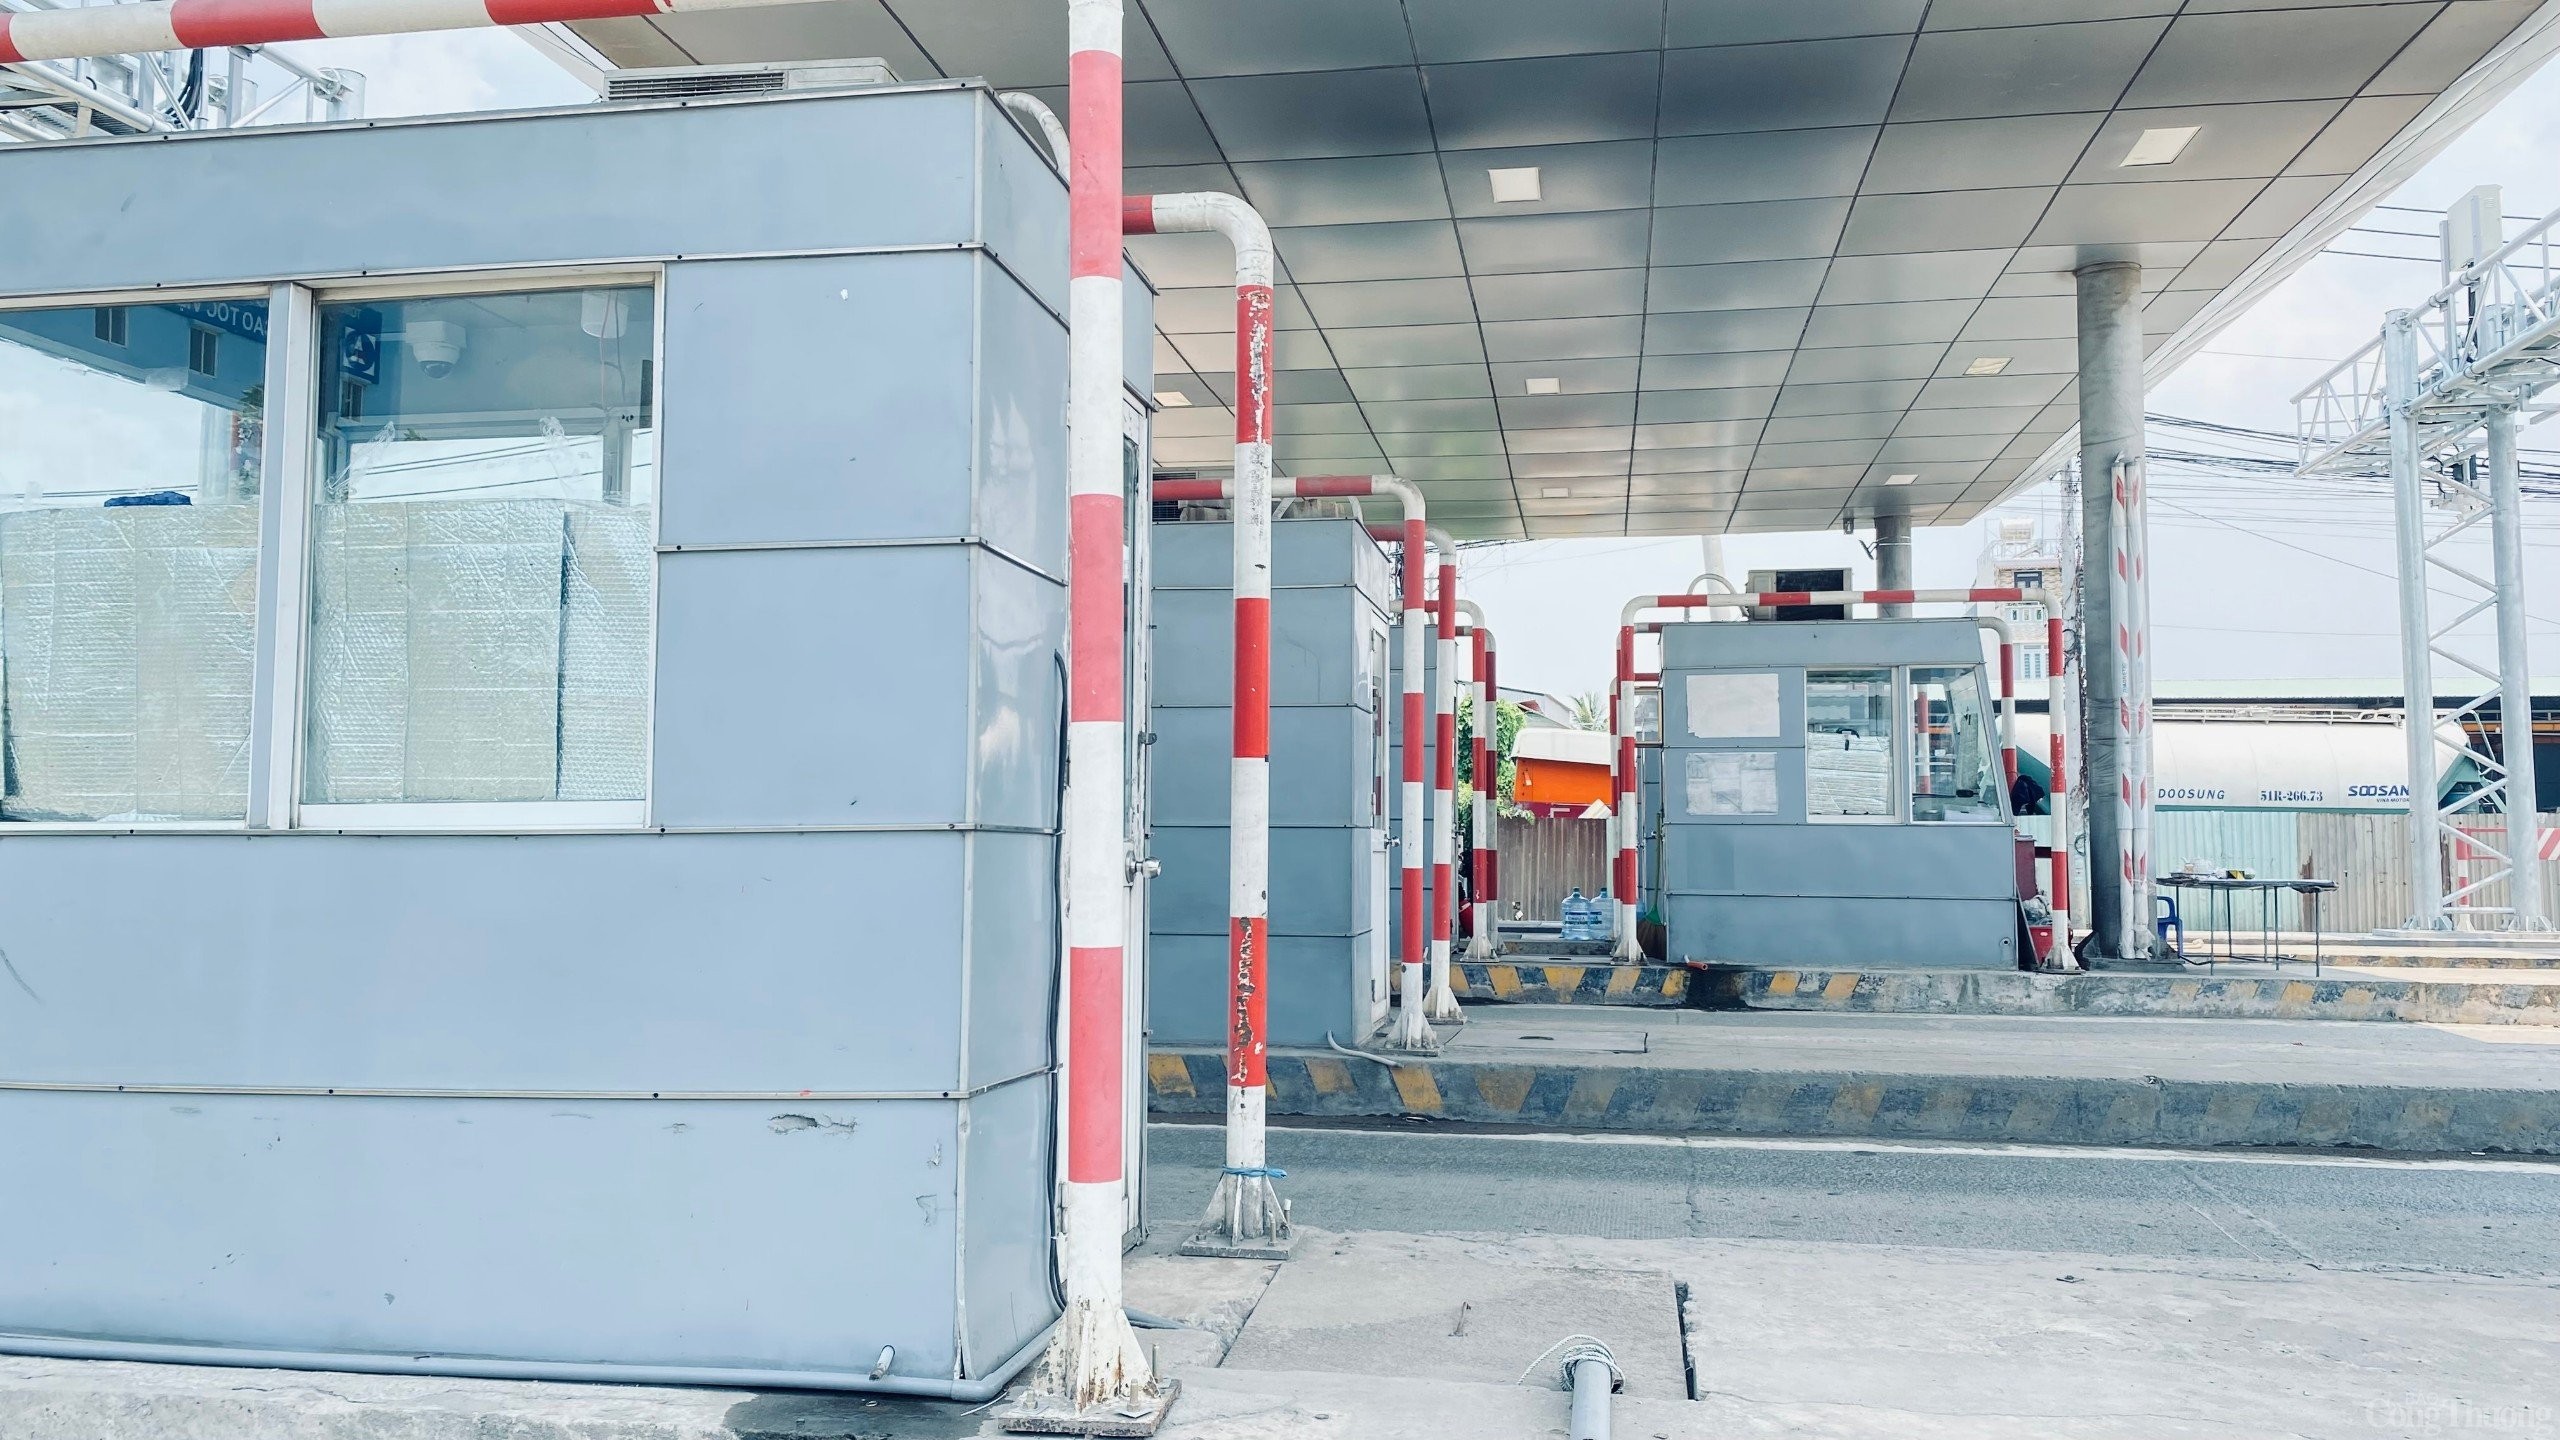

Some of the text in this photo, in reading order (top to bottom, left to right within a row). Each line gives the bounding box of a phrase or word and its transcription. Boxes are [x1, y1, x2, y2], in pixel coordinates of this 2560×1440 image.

[2158, 788, 2225, 800] DOOSUNG
[2260, 790, 2323, 801] 51R-266.73
[2347, 785, 2410, 797] SOOSAN
